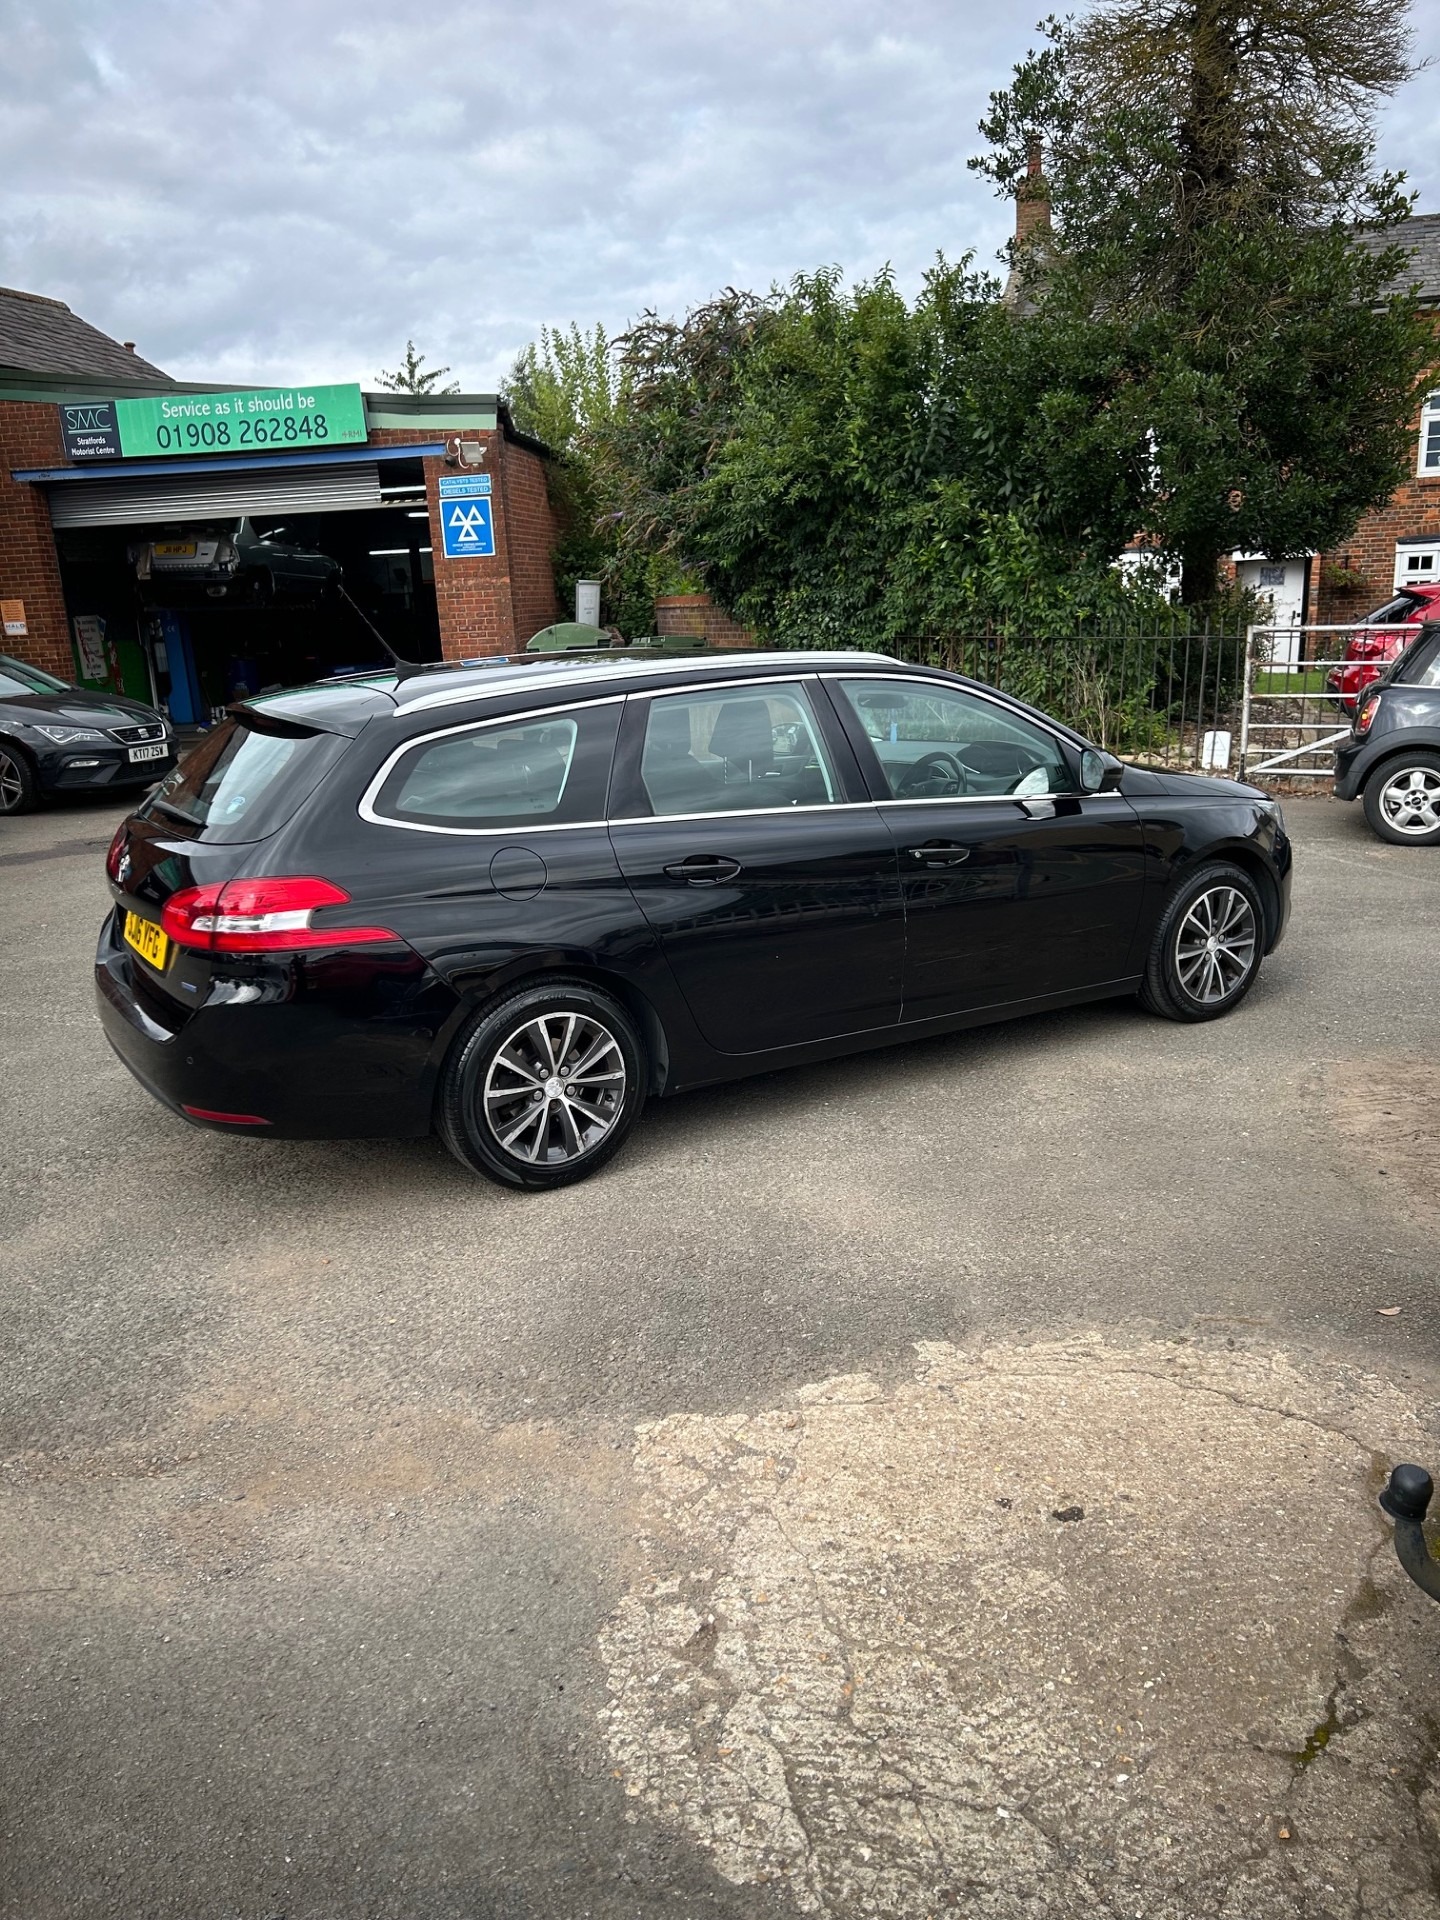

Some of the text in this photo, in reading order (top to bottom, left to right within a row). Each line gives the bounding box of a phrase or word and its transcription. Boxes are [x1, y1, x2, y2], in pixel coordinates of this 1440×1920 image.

[161, 392, 315, 419] Service as it should be
[66, 408, 111, 430] SMC
[156, 414, 329, 449] 01908 262848
[71, 446, 115, 456] Motorist Centre
[133, 747, 150, 760] KT17
